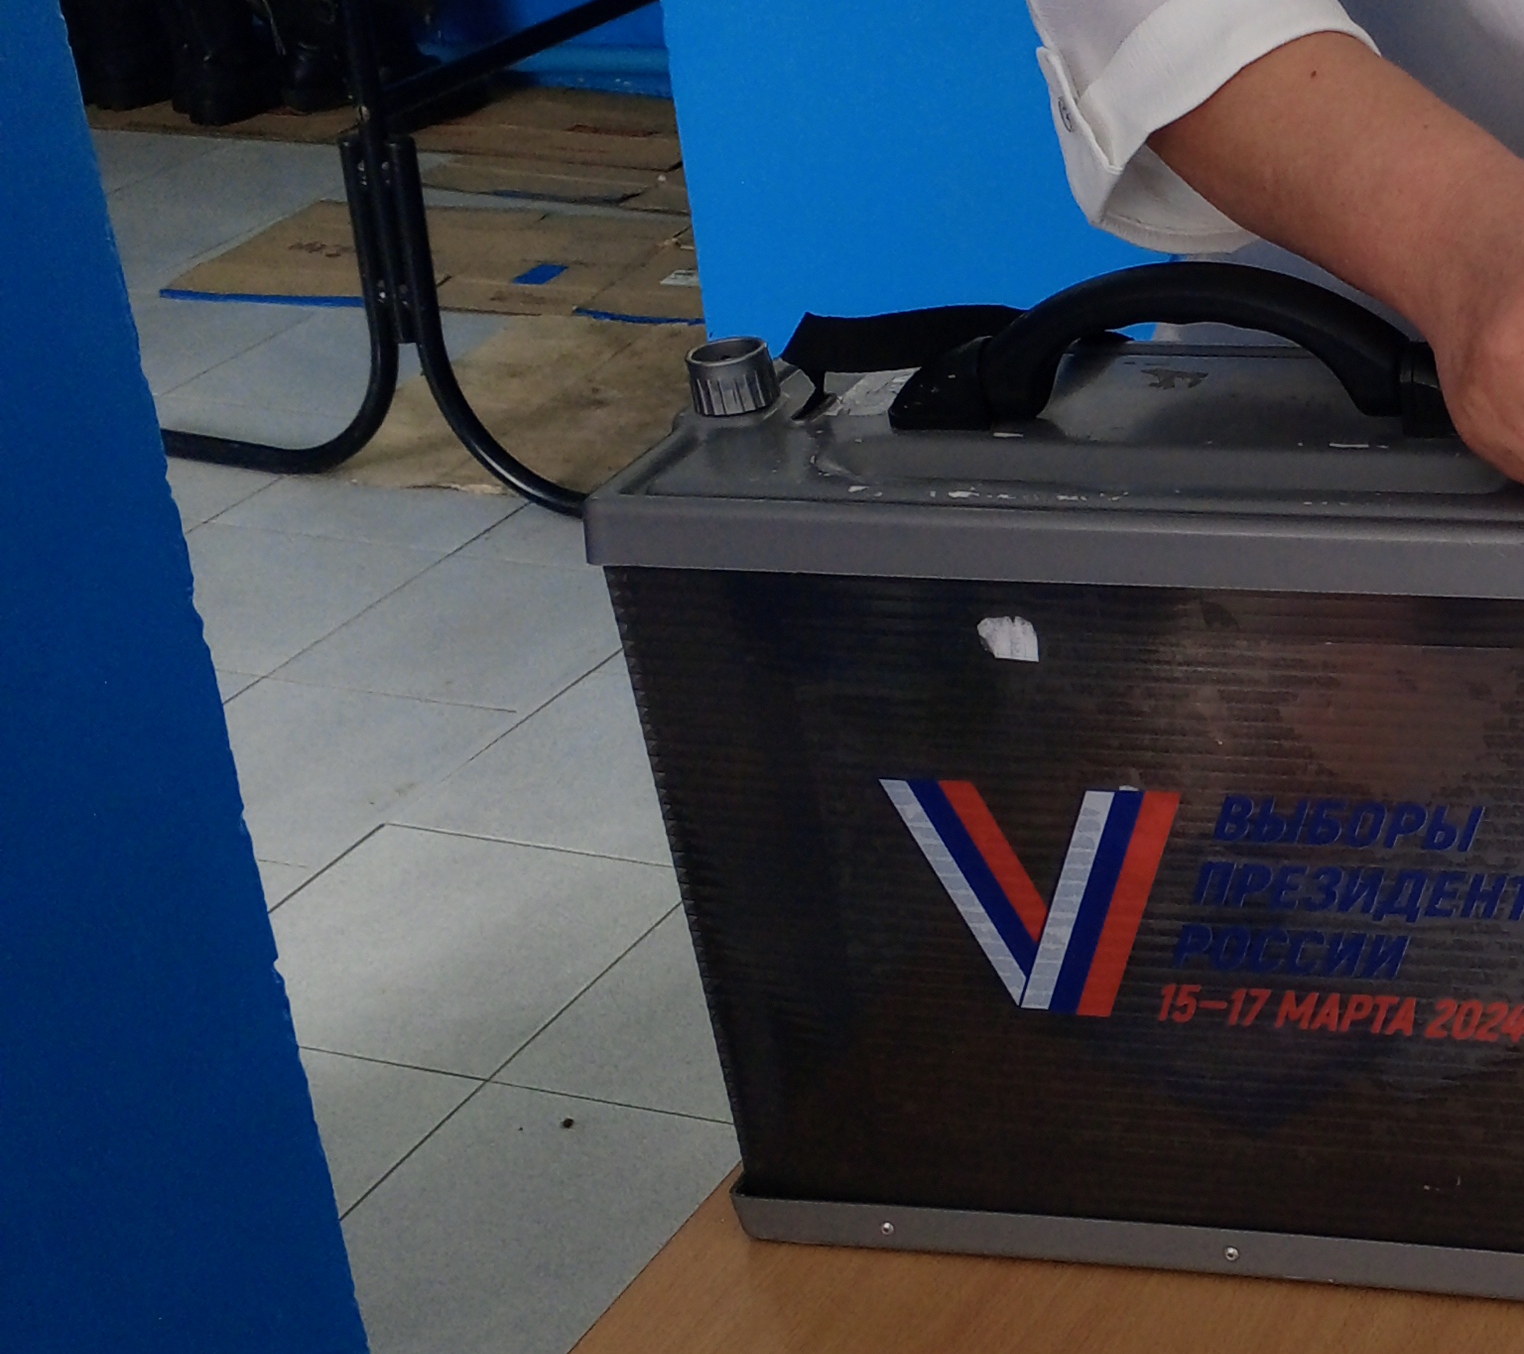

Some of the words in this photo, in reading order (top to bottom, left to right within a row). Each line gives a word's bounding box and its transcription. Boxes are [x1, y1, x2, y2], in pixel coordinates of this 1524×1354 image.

[1213, 793, 1486, 852] ВЫБОРЫ
[1172, 923, 1411, 980] РОССИИ
[1275, 989, 1417, 1038] МАРТА
